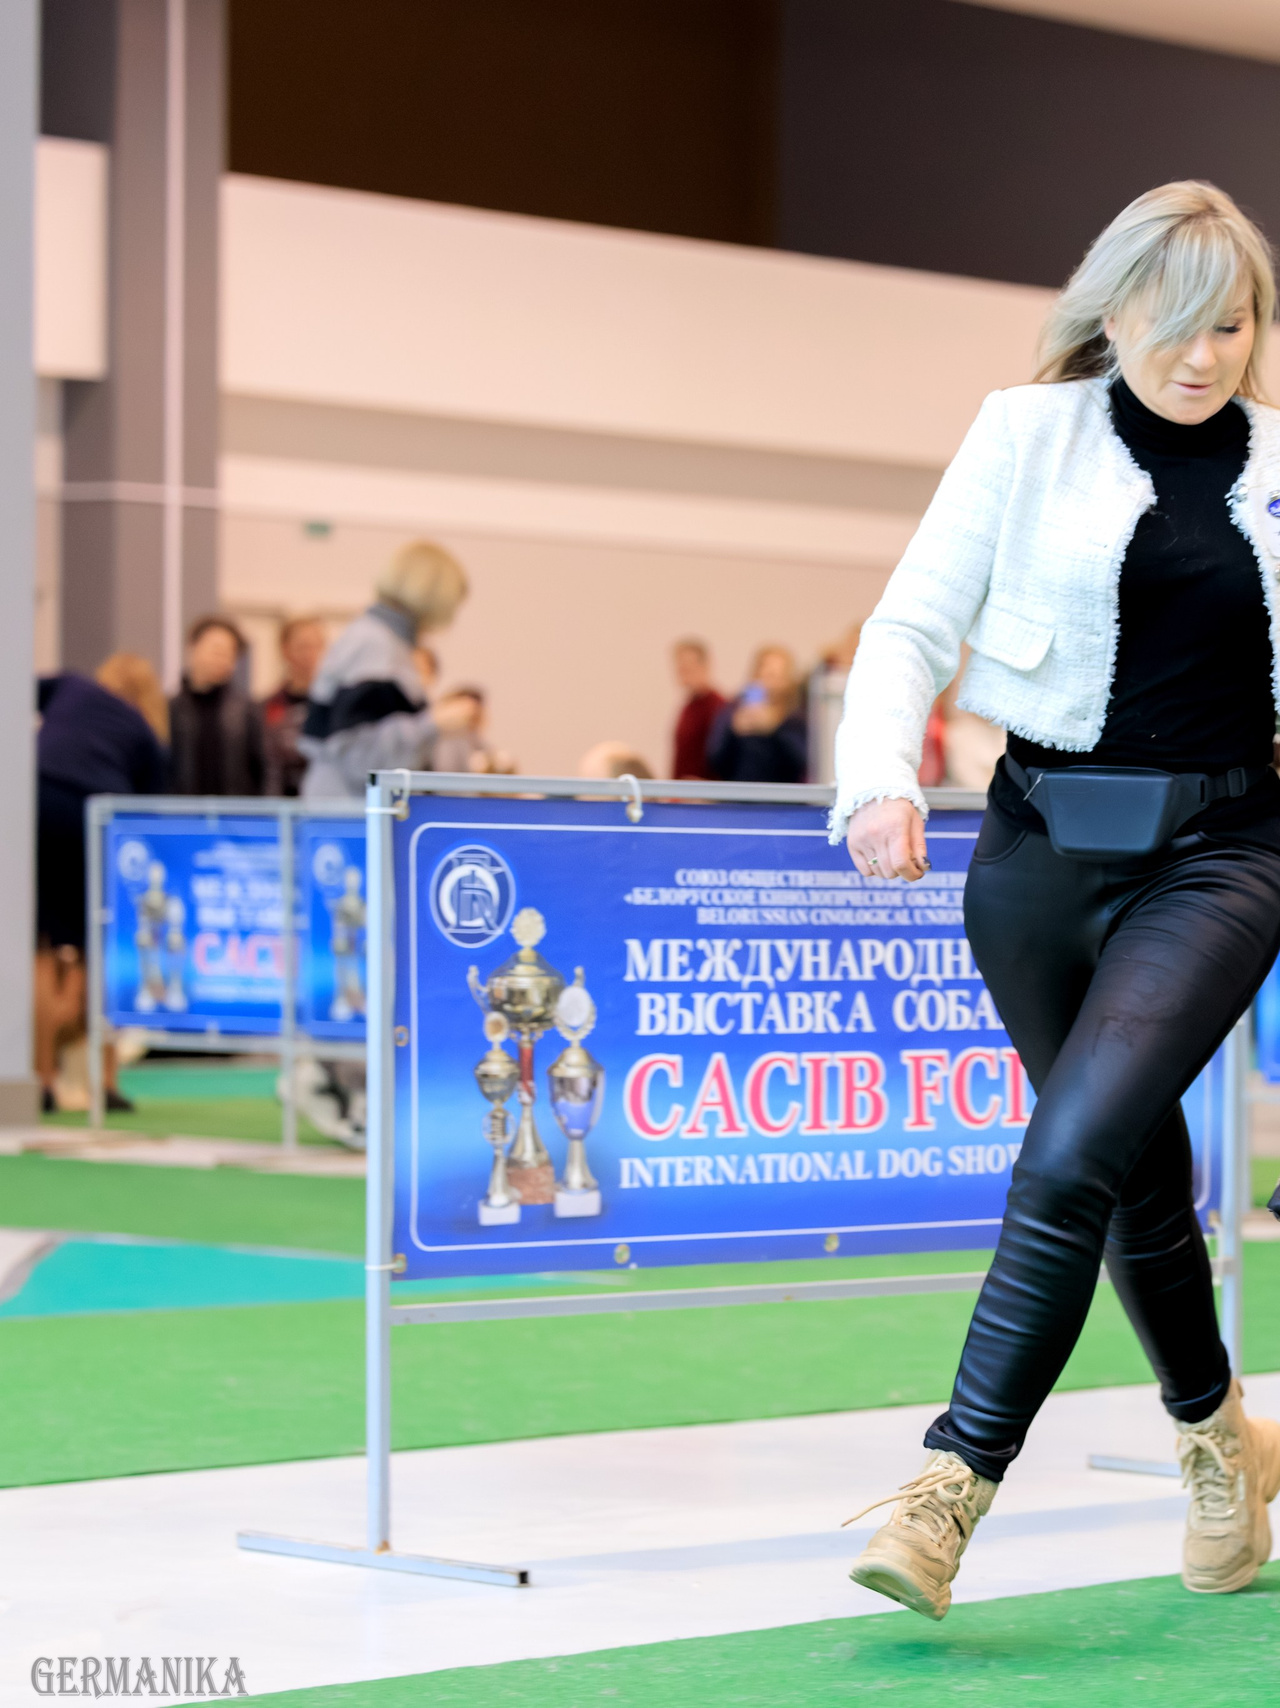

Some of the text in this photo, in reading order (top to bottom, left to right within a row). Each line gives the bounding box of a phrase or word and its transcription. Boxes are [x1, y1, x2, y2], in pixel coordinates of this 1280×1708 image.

[623, 938, 983, 990] МЕЖДУНАРОДН
[635, 988, 1006, 1035] ВЫСТАВКА СОБА
[623, 1046, 1035, 1141] CACIB FCI
[619, 1150, 873, 1188] INTERNATIONAL
[877, 1147, 943, 1179] DOG
